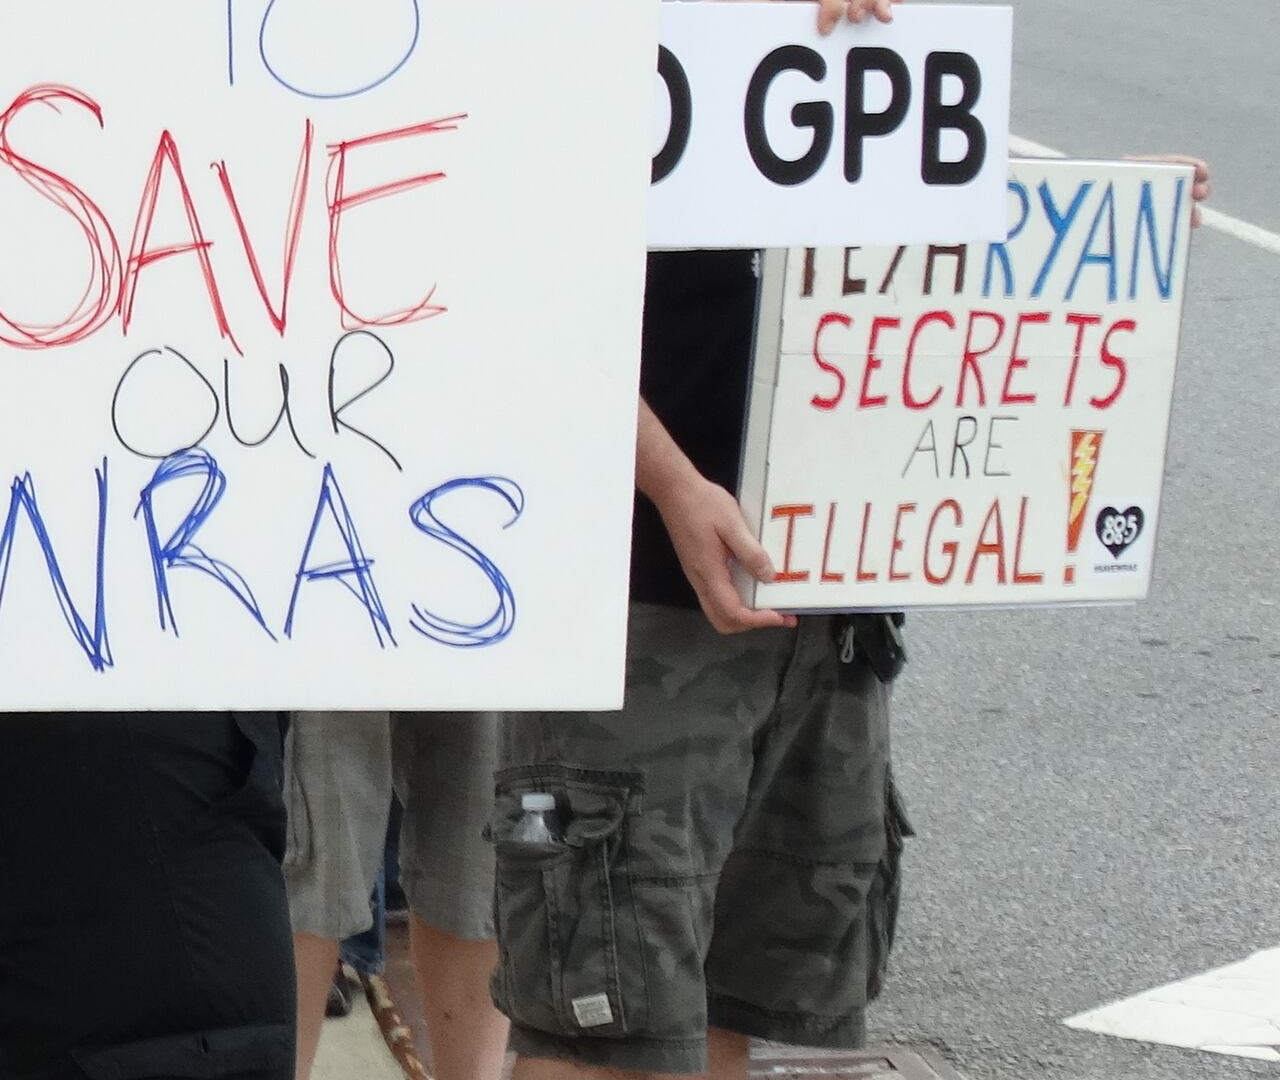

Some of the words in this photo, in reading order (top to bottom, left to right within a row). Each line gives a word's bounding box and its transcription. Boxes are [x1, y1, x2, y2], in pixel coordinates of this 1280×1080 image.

[743, 42, 988, 188] GPB
[111, 329, 403, 472] OUR
[809, 310, 1138, 412] SECRETS
[901, 415, 1020, 480] ARE
